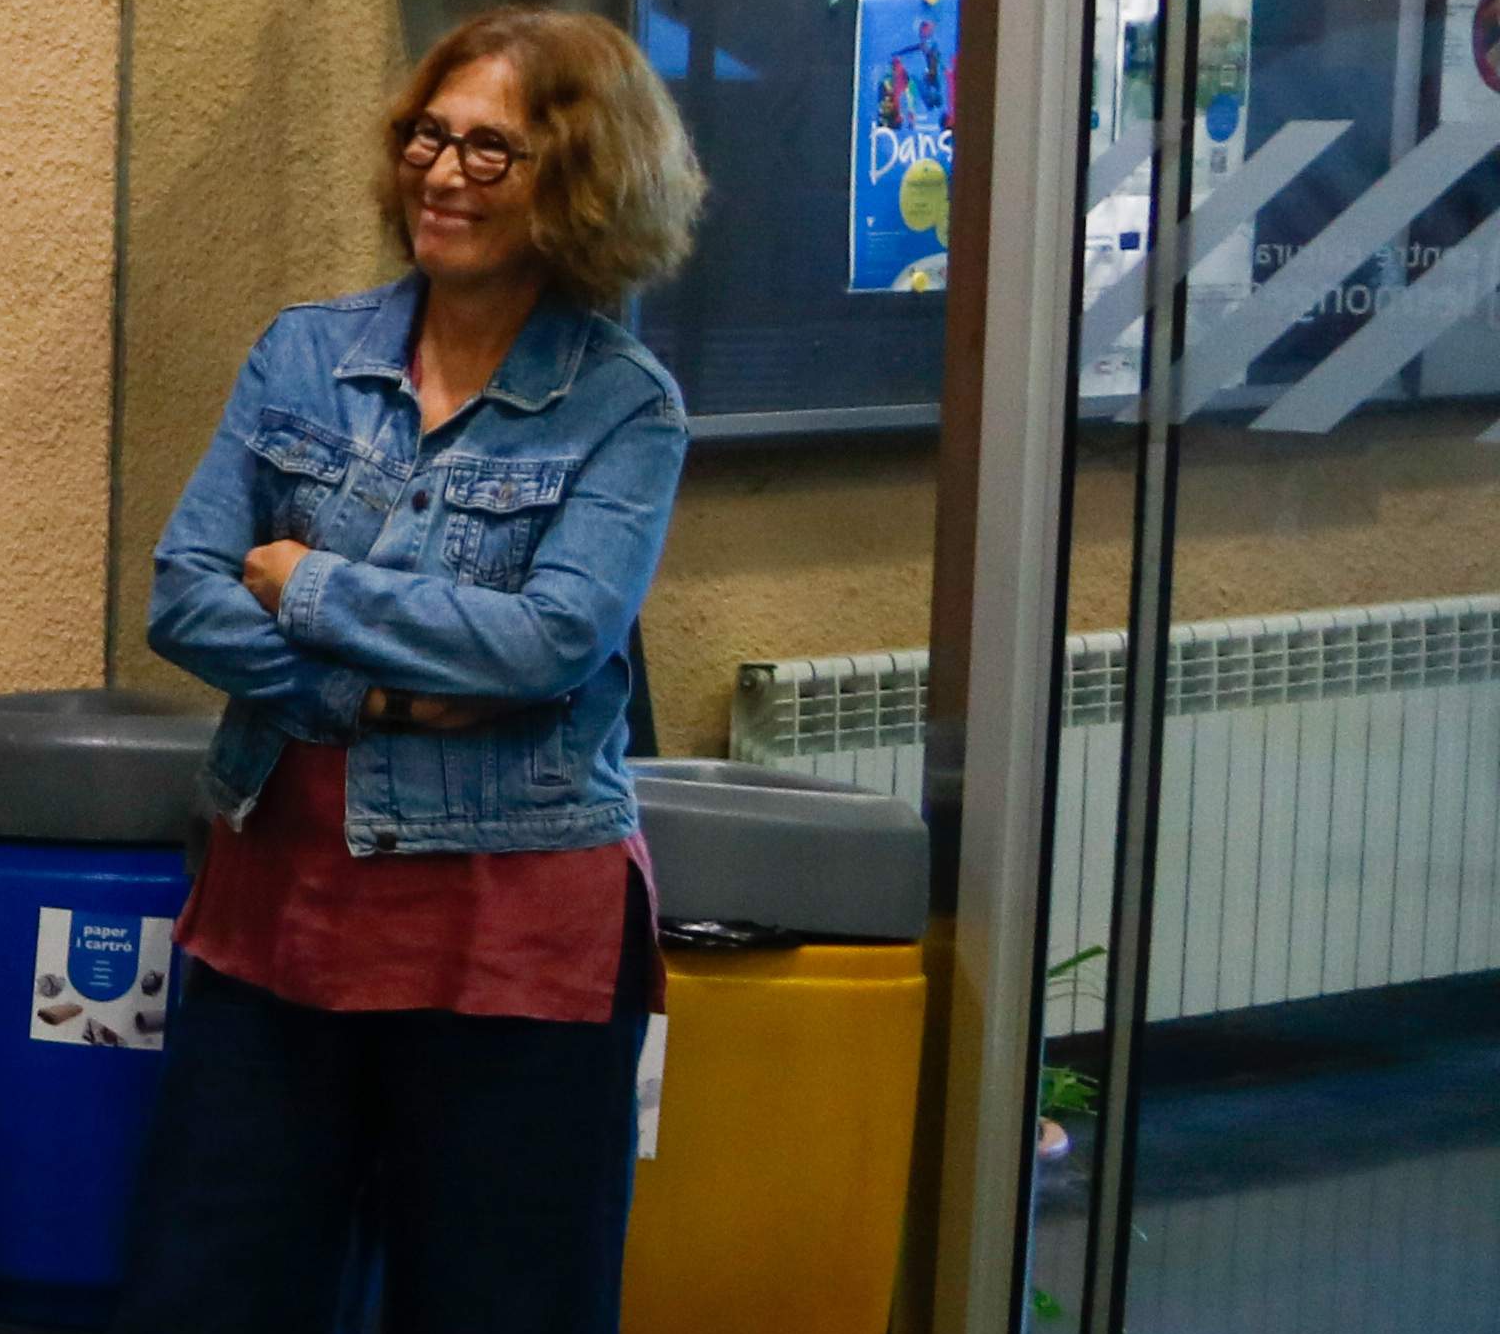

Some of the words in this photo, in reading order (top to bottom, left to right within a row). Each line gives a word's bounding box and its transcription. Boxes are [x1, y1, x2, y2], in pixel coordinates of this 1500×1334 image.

[870, 122, 953, 186] Dans
[83, 924, 128, 939] paper
[85, 938, 133, 953] cartró
